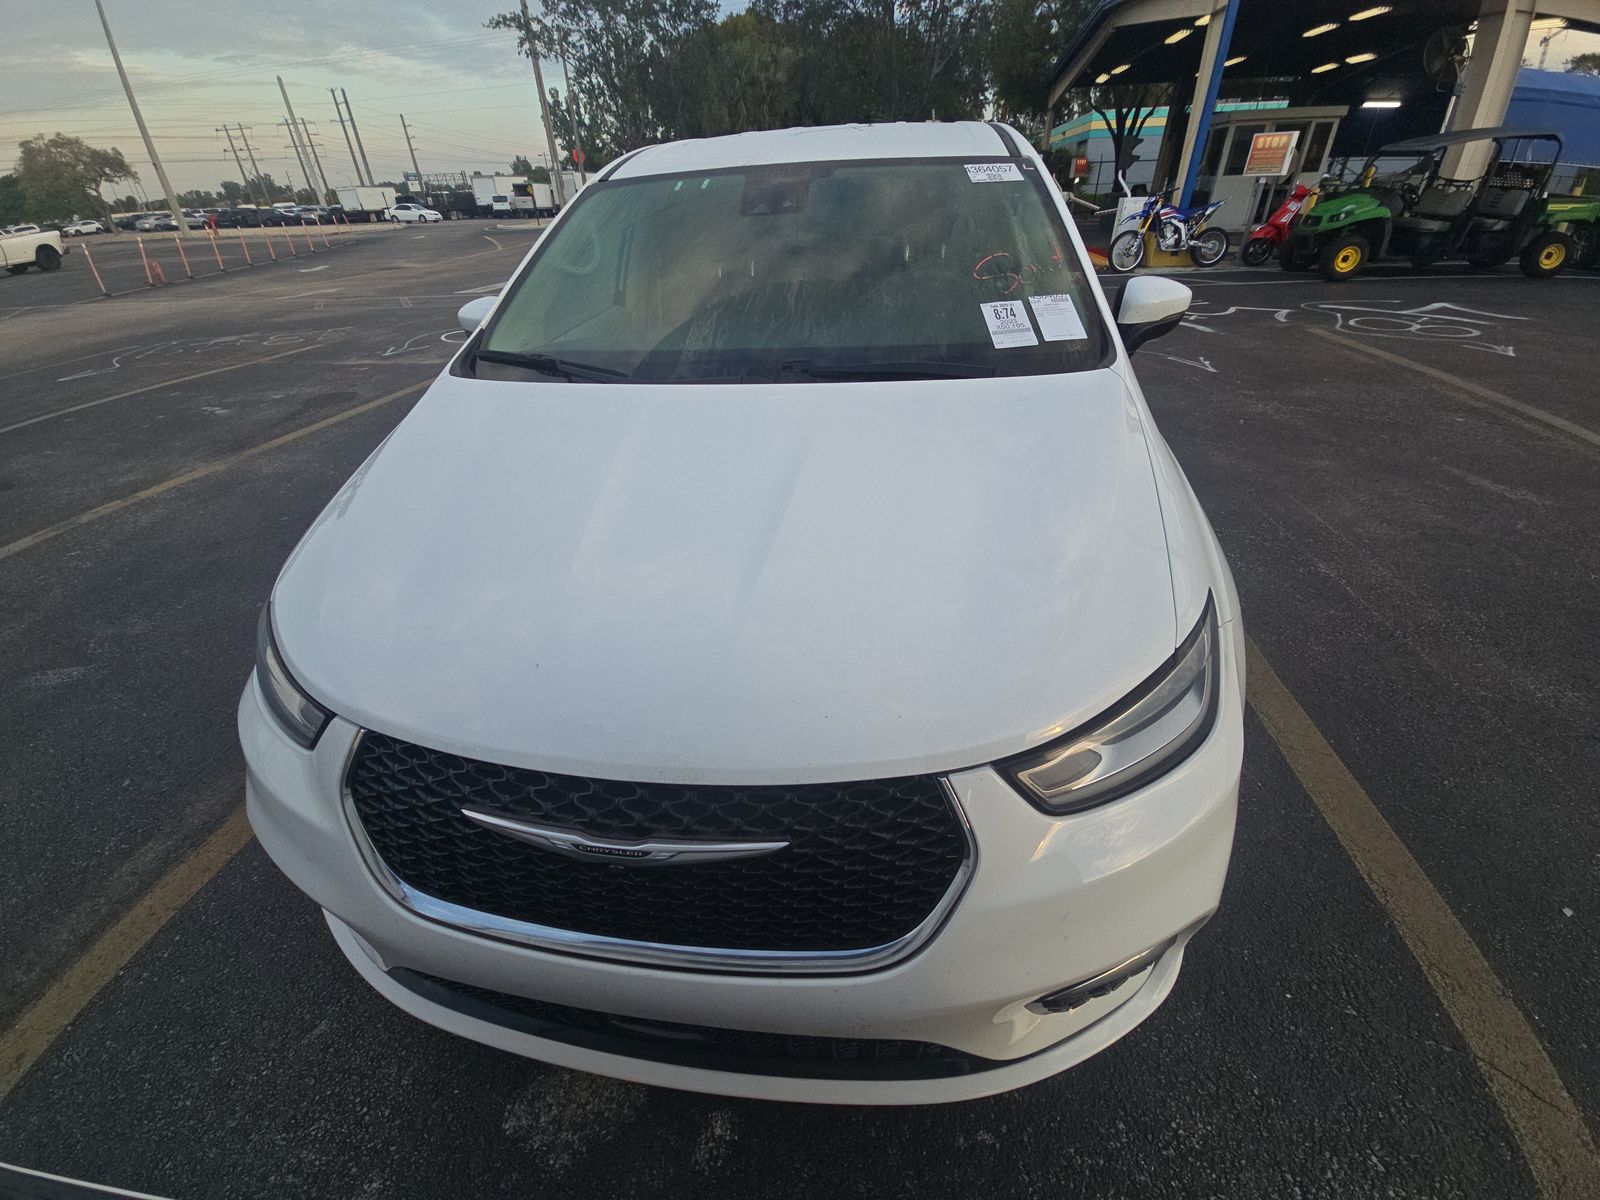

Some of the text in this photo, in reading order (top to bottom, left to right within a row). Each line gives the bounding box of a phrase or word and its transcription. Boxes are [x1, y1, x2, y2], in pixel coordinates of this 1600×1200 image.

[1256, 136, 1288, 149] STOP
[993, 307, 1017, 320] 8:74
[579, 845, 642, 857] CHRYSLER
